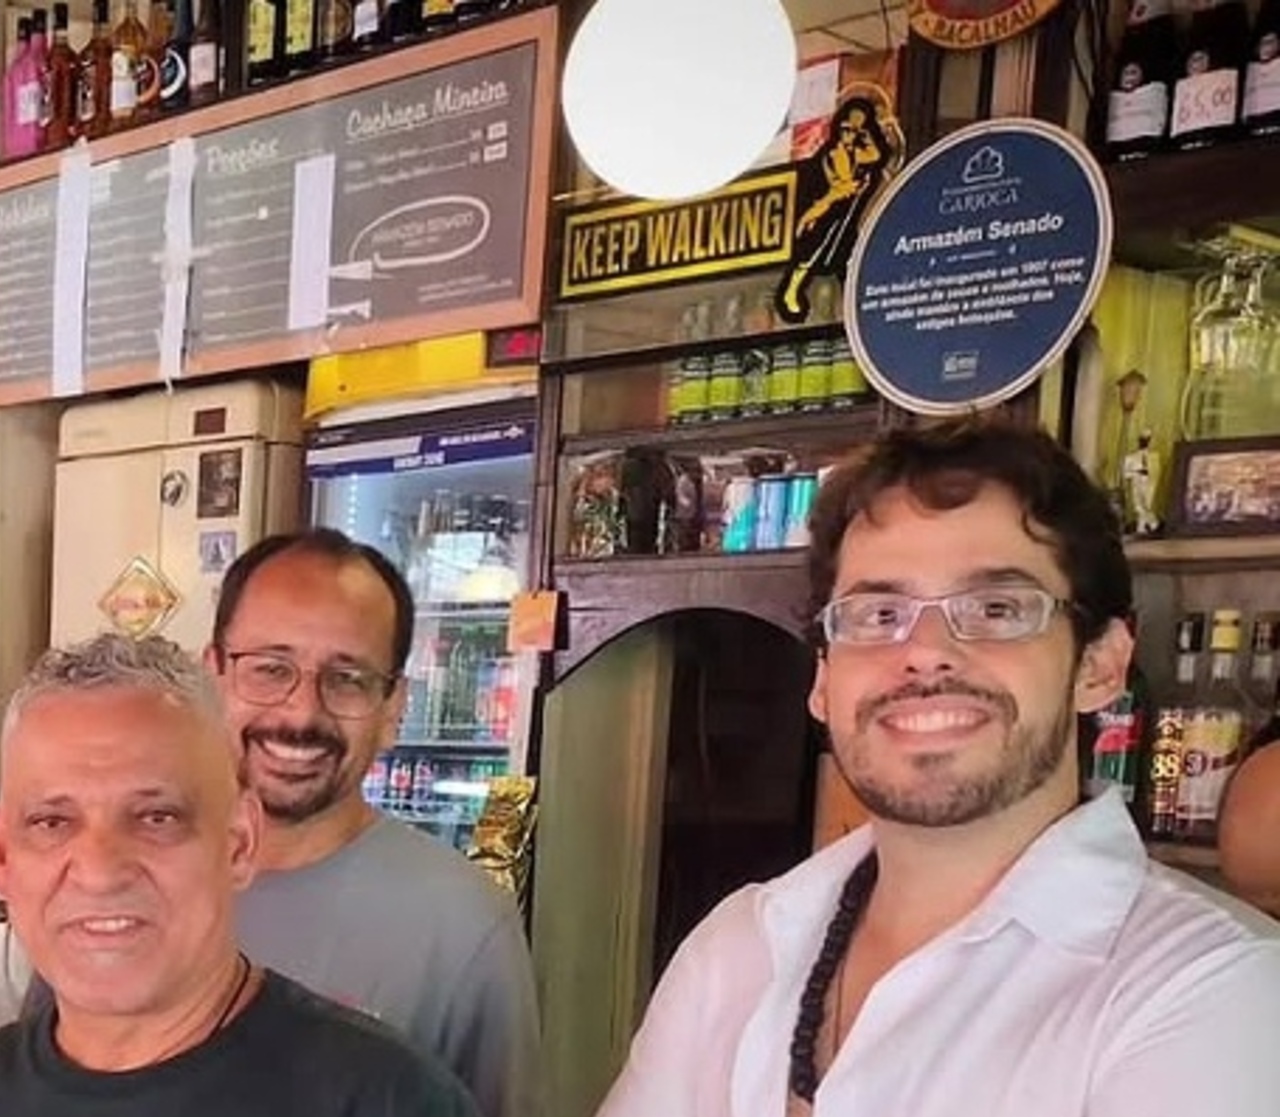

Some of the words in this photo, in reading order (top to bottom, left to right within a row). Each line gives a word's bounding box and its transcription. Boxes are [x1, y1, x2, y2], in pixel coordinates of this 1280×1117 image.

[573, 219, 640, 280] KEEP
[646, 191, 783, 267] WALKING
[894, 226, 983, 254] Armazém
[988, 212, 1064, 240] Senado
